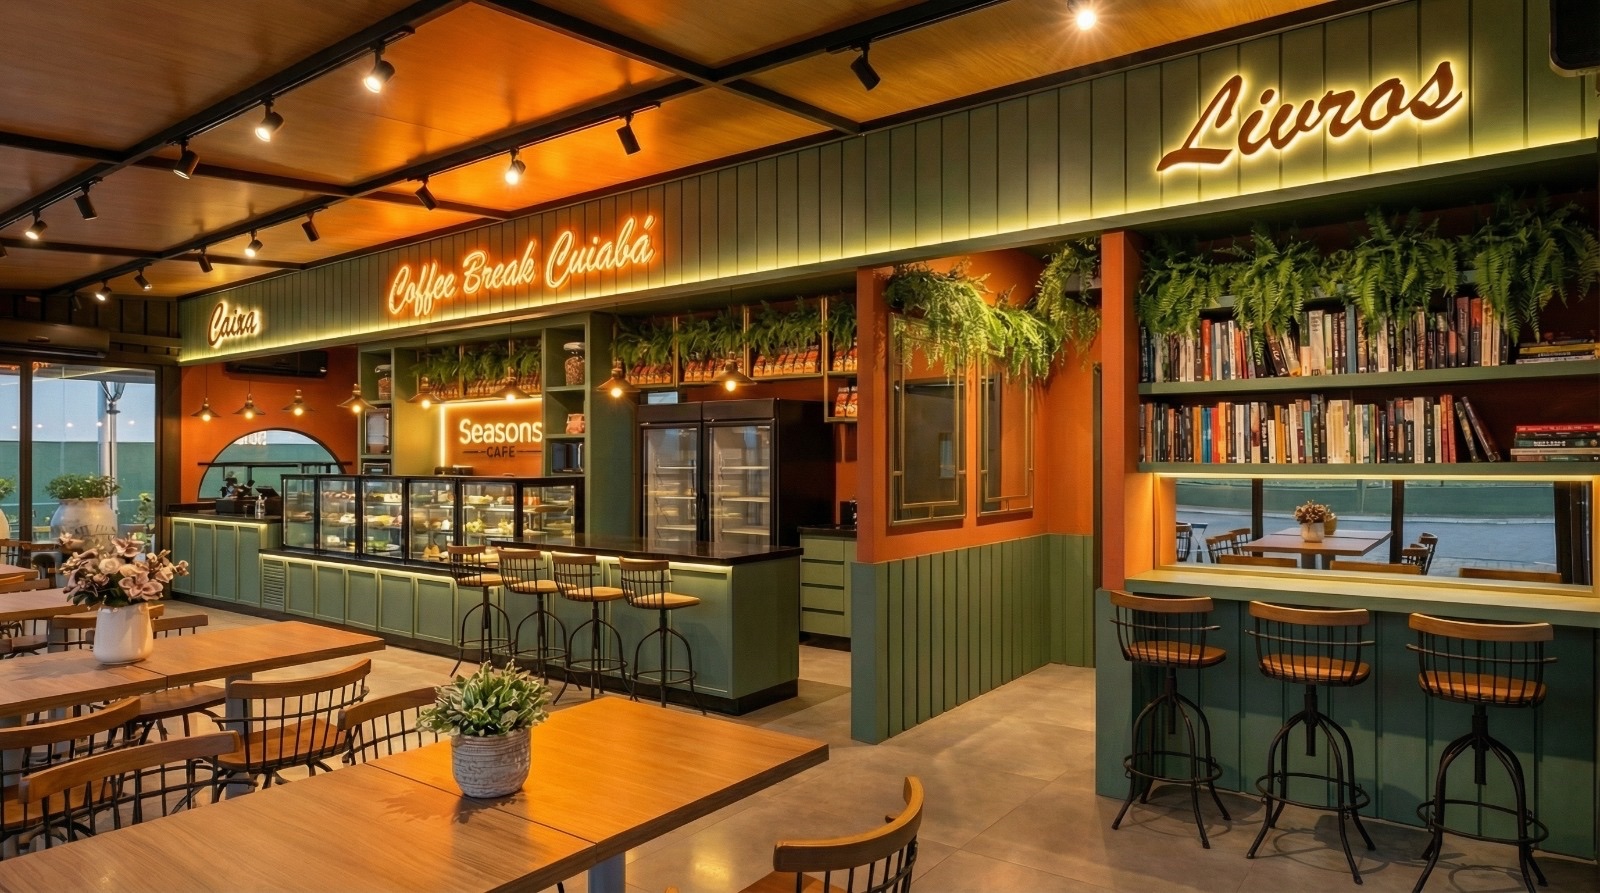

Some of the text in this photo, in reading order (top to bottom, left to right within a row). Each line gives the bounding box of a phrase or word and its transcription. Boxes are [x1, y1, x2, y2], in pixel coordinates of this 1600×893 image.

[1156, 61, 1463, 172] Livros
[388, 215, 656, 317] Coffee Break Cuiabá
[207, 302, 258, 347] Caixa
[459, 418, 543, 445] Seasons
[486, 446, 516, 458] CAFE
